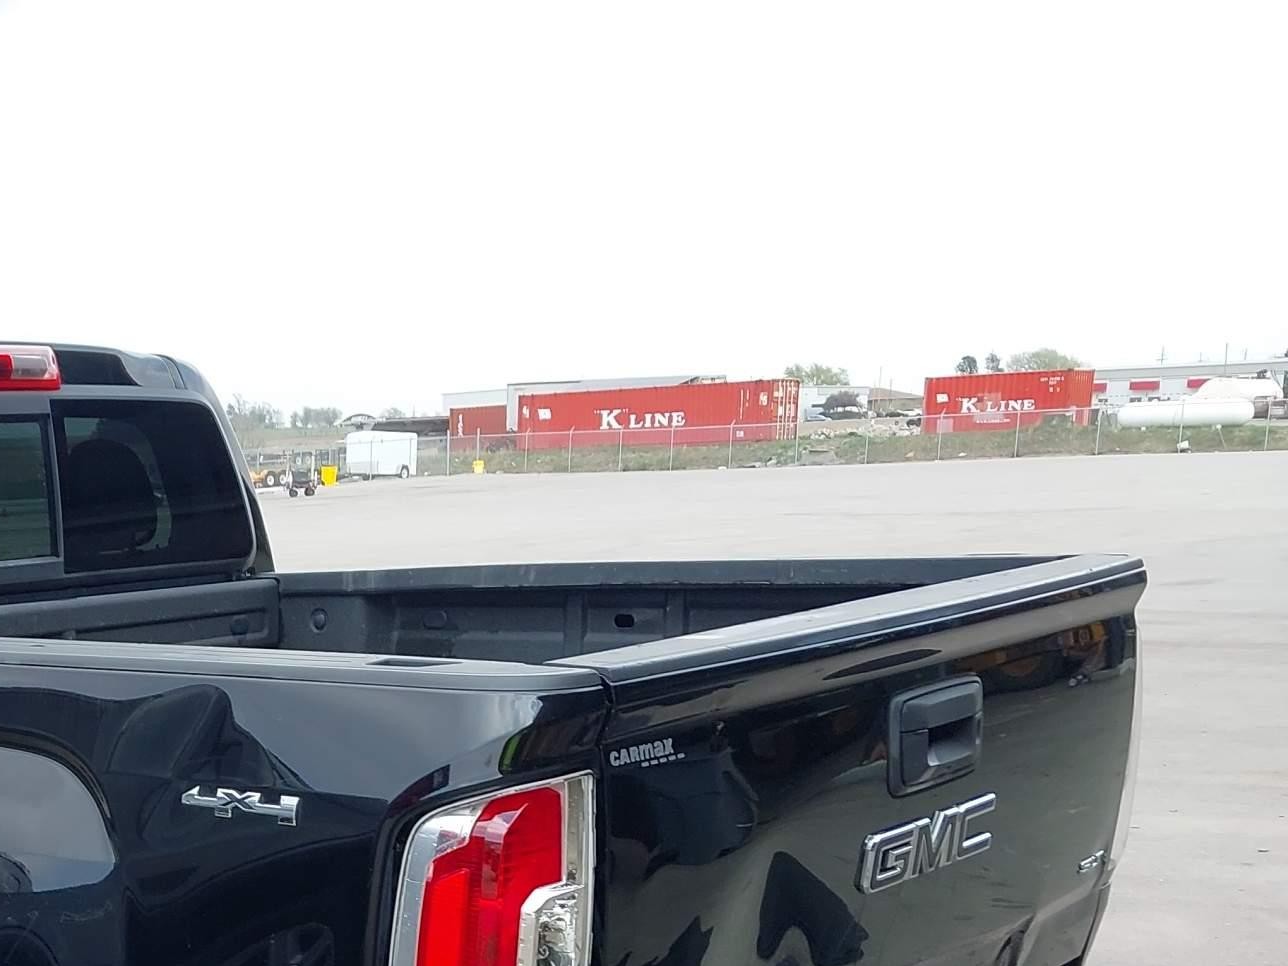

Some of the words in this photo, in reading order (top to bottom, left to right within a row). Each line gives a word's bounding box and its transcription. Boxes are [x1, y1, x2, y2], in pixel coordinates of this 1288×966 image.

[986, 399, 1036, 412] LINE
[629, 411, 686, 429] LINE
[854, 791, 997, 896] GMC
